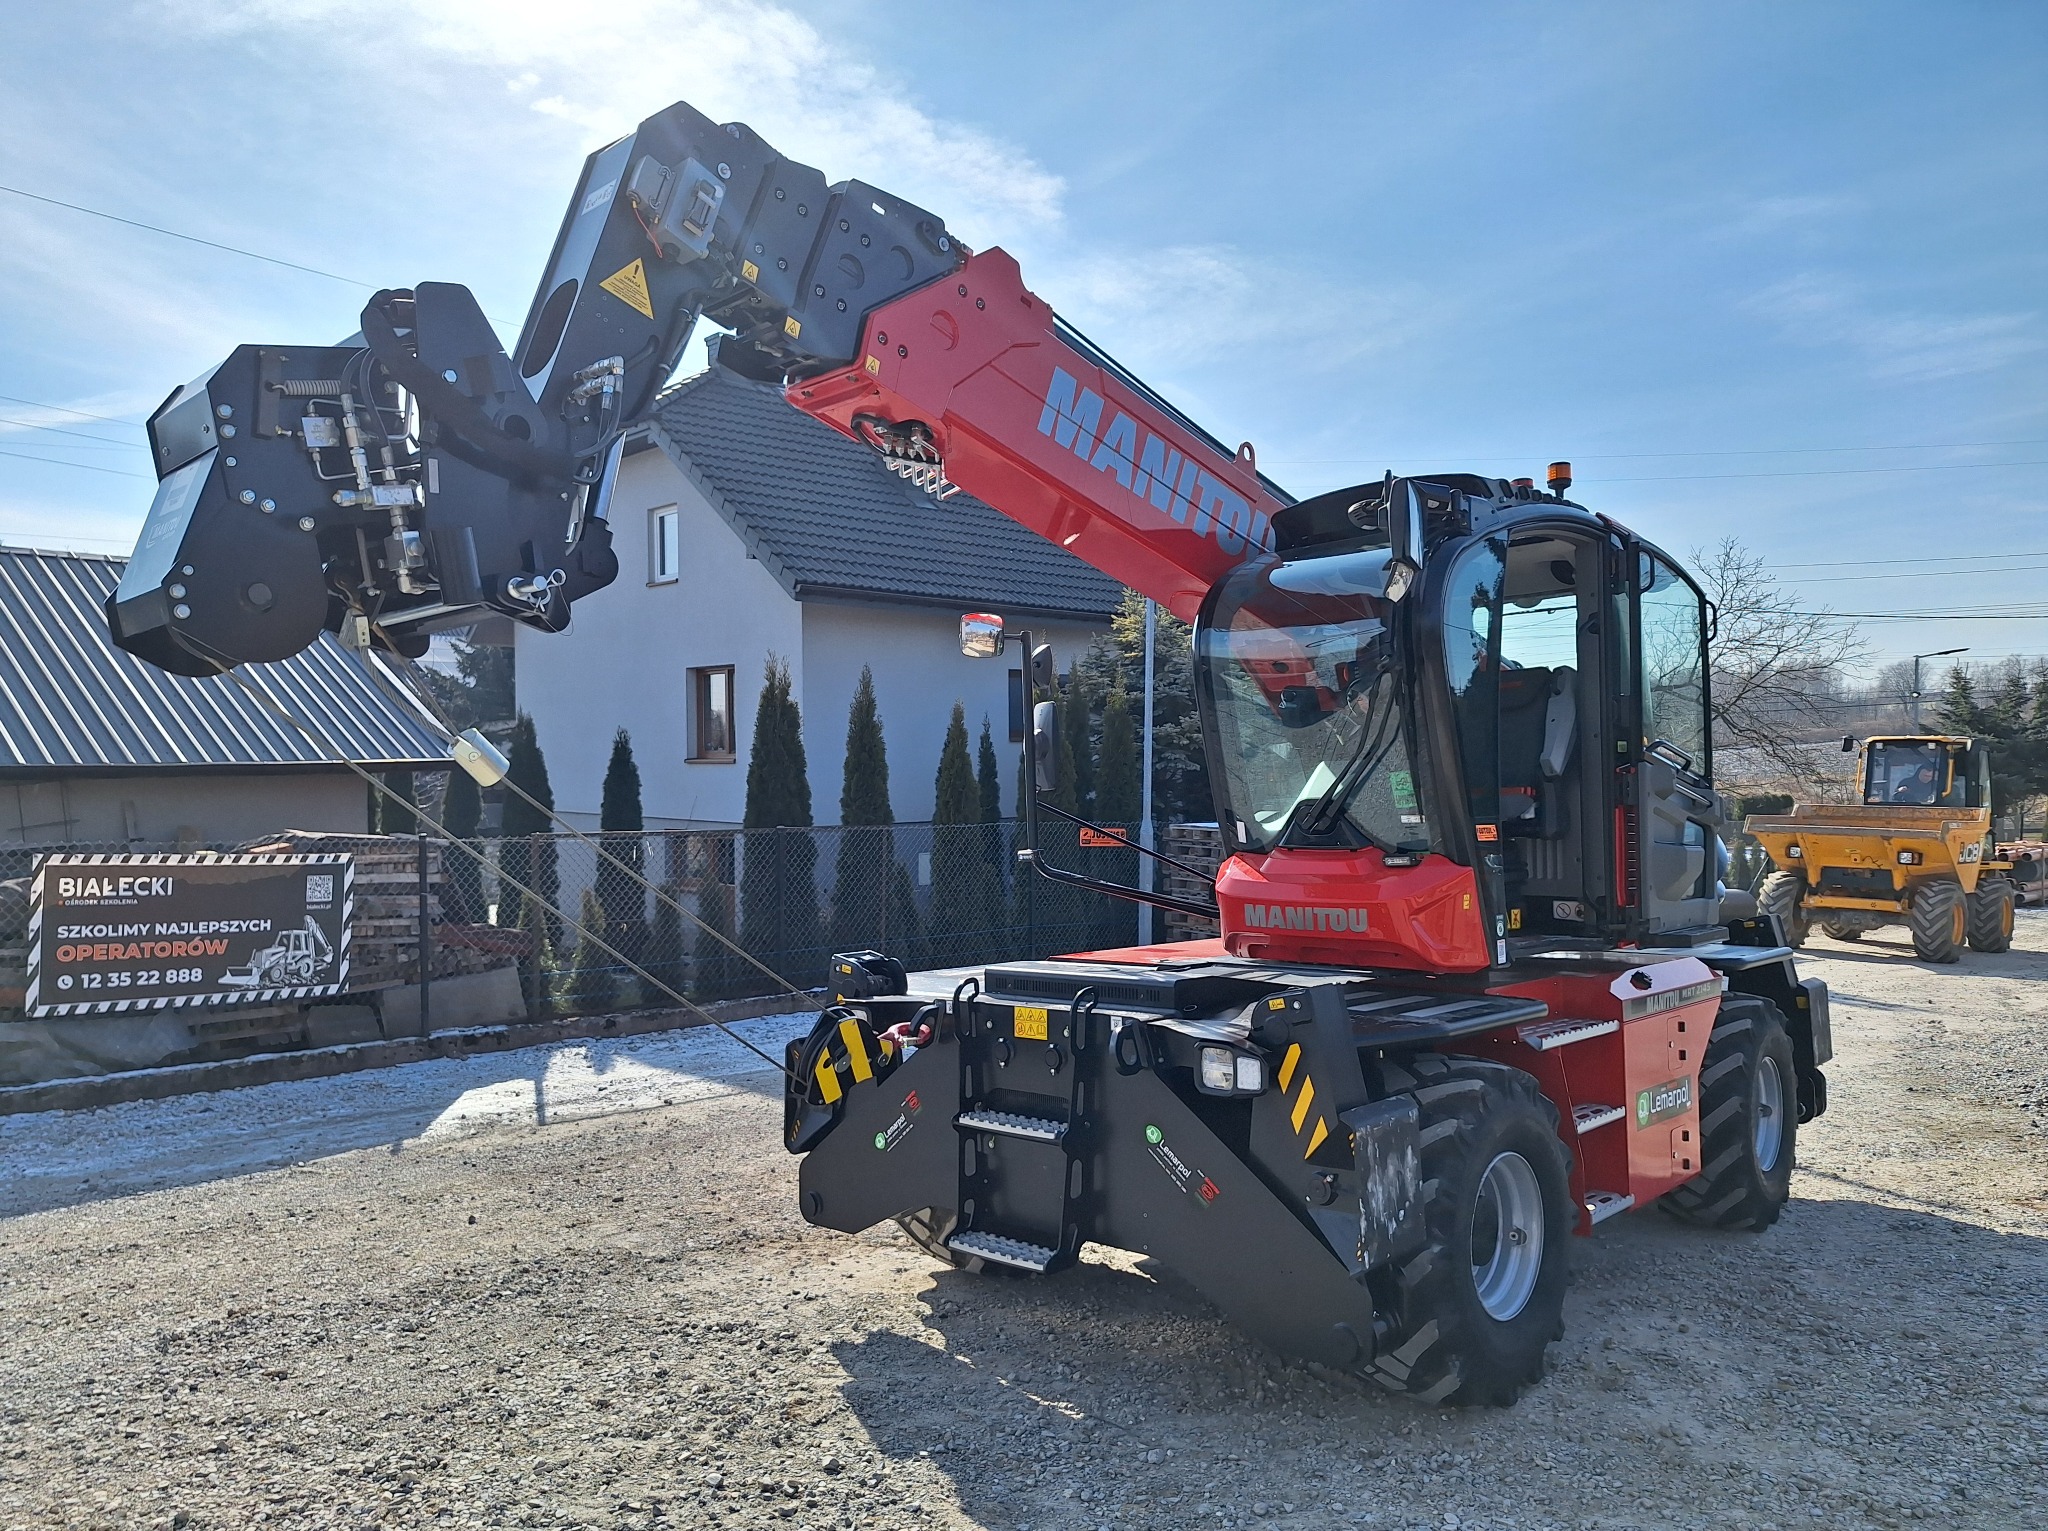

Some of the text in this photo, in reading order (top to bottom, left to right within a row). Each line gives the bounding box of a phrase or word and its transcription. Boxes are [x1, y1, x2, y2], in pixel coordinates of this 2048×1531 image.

[623, 275, 641, 289] UWAGA
[1037, 366, 1277, 561] MANITOU
[1959, 843, 1980, 863] JCB
[58, 877, 173, 897] BIAŁECKI
[64, 898, 98, 906] OŚRODEK
[57, 919, 271, 939] SZKOLIMY NAJLEPSZYCH
[1244, 903, 1368, 933] MANITOU
[56, 936, 228, 962] OPERATORÓW
[81, 968, 202, 989] 12 35 22 888
[1646, 982, 1711, 1014] MANITOU MRT 2145
[1650, 1080, 1689, 1113] Lemarpol
[884, 1113, 906, 1138] Lemarpol
[1160, 1139, 1191, 1178] Lemarpol
